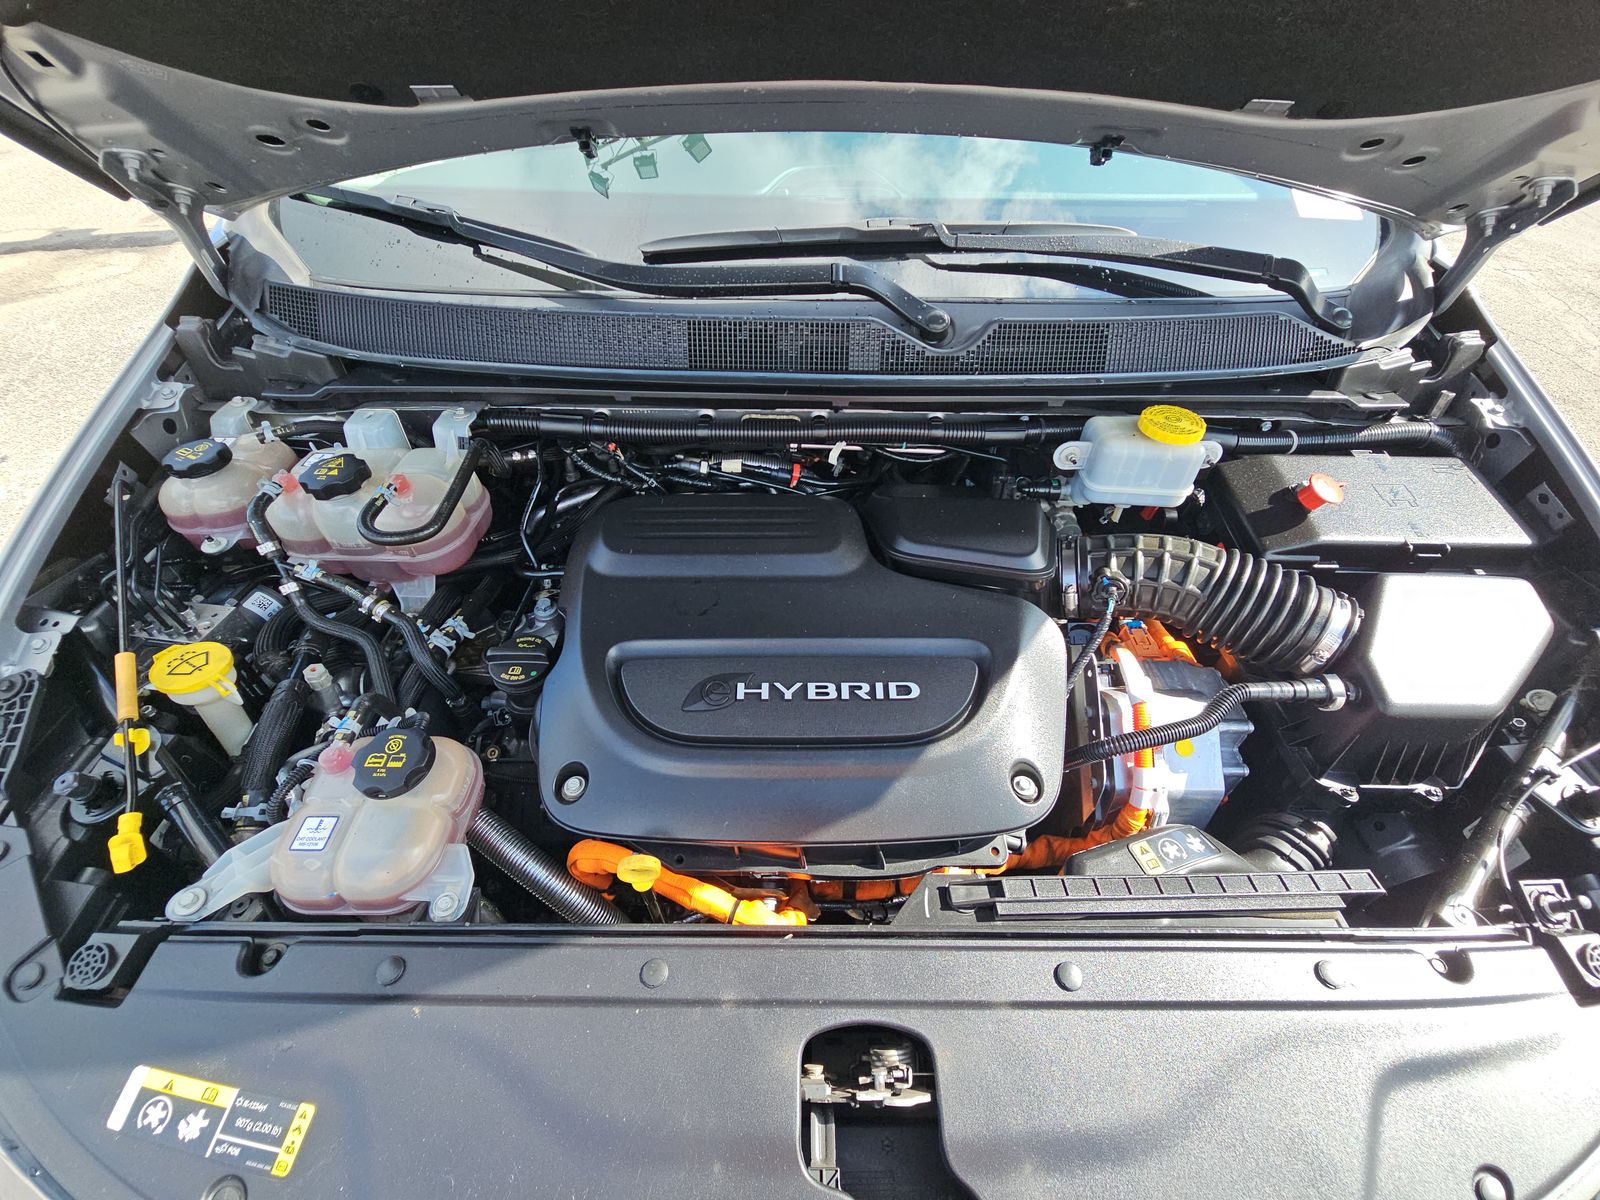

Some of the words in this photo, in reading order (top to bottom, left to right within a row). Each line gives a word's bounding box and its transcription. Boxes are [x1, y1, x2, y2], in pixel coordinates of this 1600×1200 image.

[735, 681, 921, 700] HYBRID
[253, 1120, 272, 1133] (2.00
[270, 1124, 282, 1138] lb)
